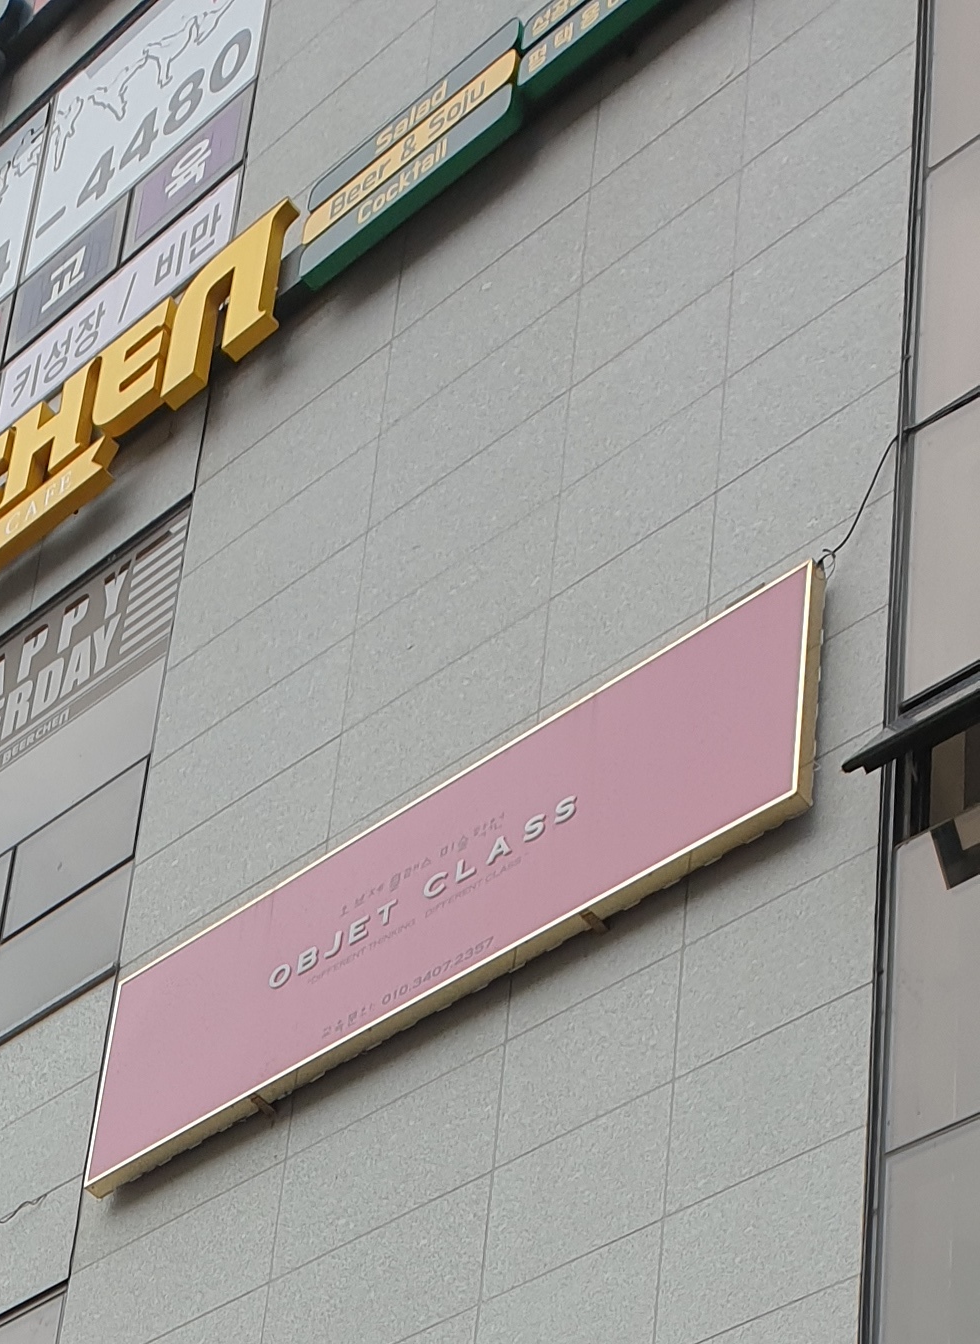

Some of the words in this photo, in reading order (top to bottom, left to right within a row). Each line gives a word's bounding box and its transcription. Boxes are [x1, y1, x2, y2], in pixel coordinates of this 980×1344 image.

[35, 29, 253, 240] -4480
[328, 163, 391, 220] Beer
[400, 136, 417, 160] &
[427, 81, 487, 142] Soju
[357, 140, 448, 224] Cocktail
[374, 80, 448, 155] Salad
[13, 305, 106, 402] 키성장
[154, 200, 222, 280] 비만
[3, 474, 73, 537] CAFE
[268, 899, 399, 990] OBJET
[423, 794, 578, 899] CLASS
